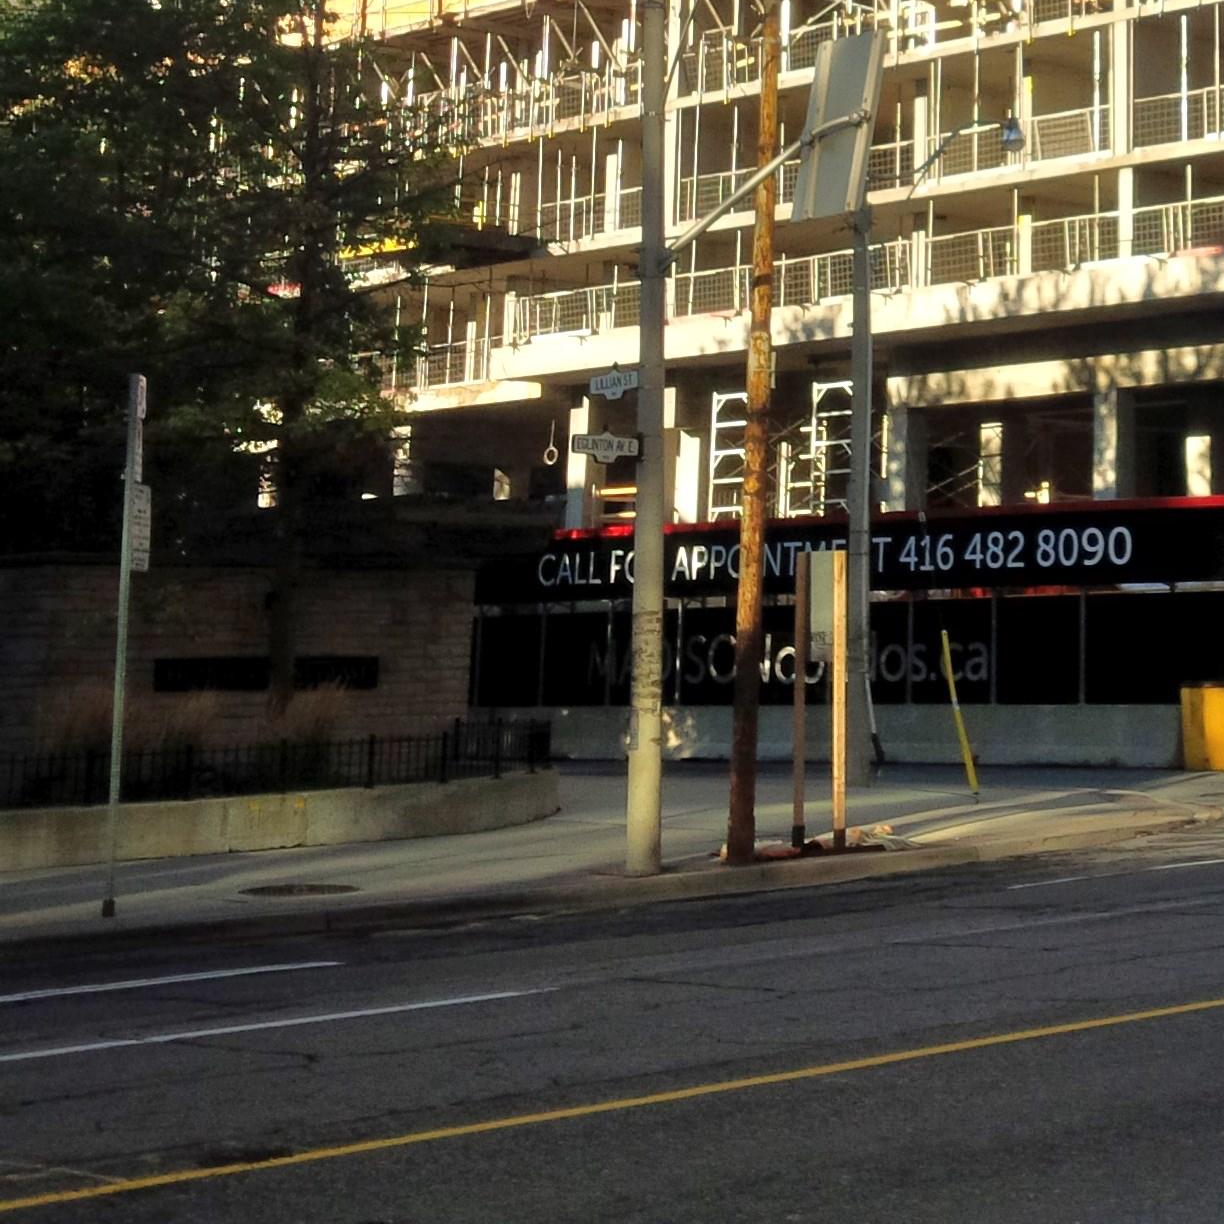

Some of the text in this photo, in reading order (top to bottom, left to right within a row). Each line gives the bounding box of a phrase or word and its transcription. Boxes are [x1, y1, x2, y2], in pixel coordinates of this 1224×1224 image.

[623, 373, 632, 386] ST
[537, 550, 602, 587] CALL
[671, 536, 893, 582] APPONTT
[899, 534, 955, 573] 416
[963, 530, 1026, 570] 482
[1035, 525, 1133, 567] 8090
[586, 629, 990, 687] MSONcos.ca
